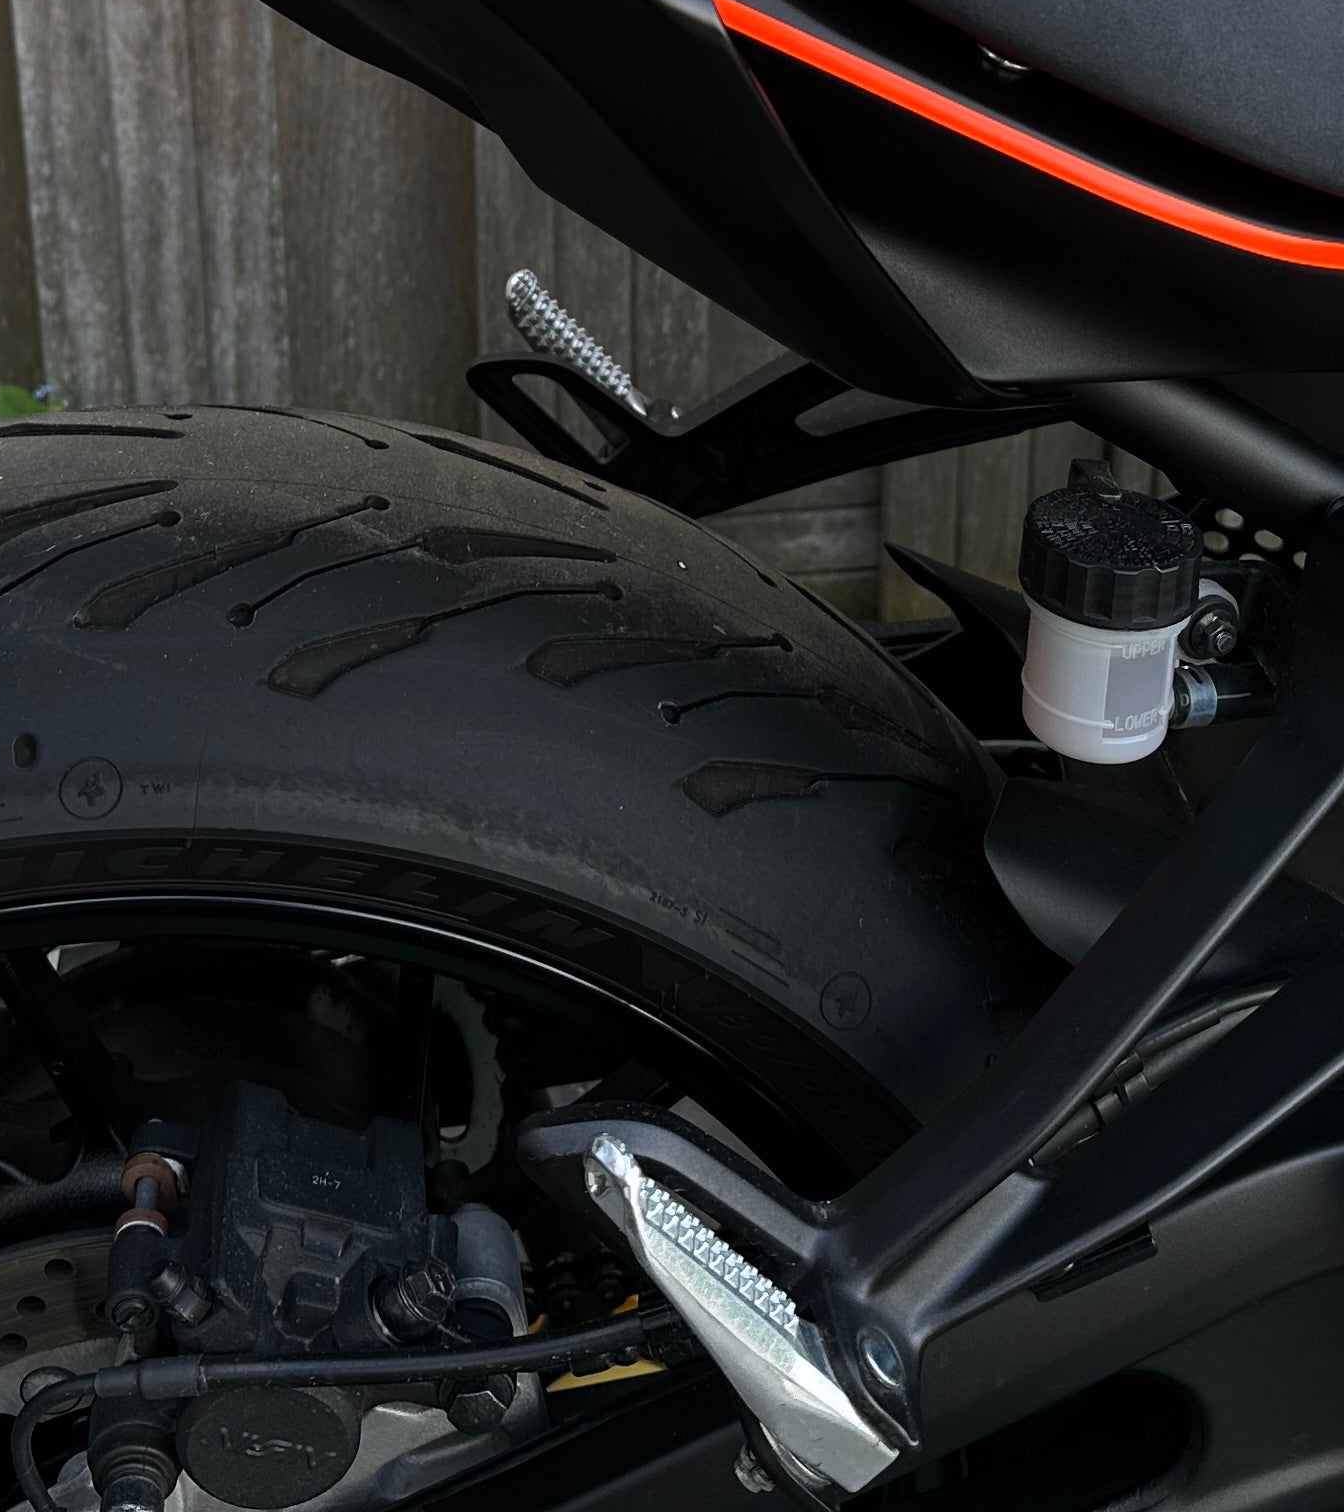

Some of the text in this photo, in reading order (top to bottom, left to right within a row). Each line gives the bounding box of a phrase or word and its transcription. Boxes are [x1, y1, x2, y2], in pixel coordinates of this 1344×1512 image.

[1122, 640, 1165, 659] UPPER
[1114, 709, 1156, 731] LOWER
[140, 783, 171, 794] TWI
